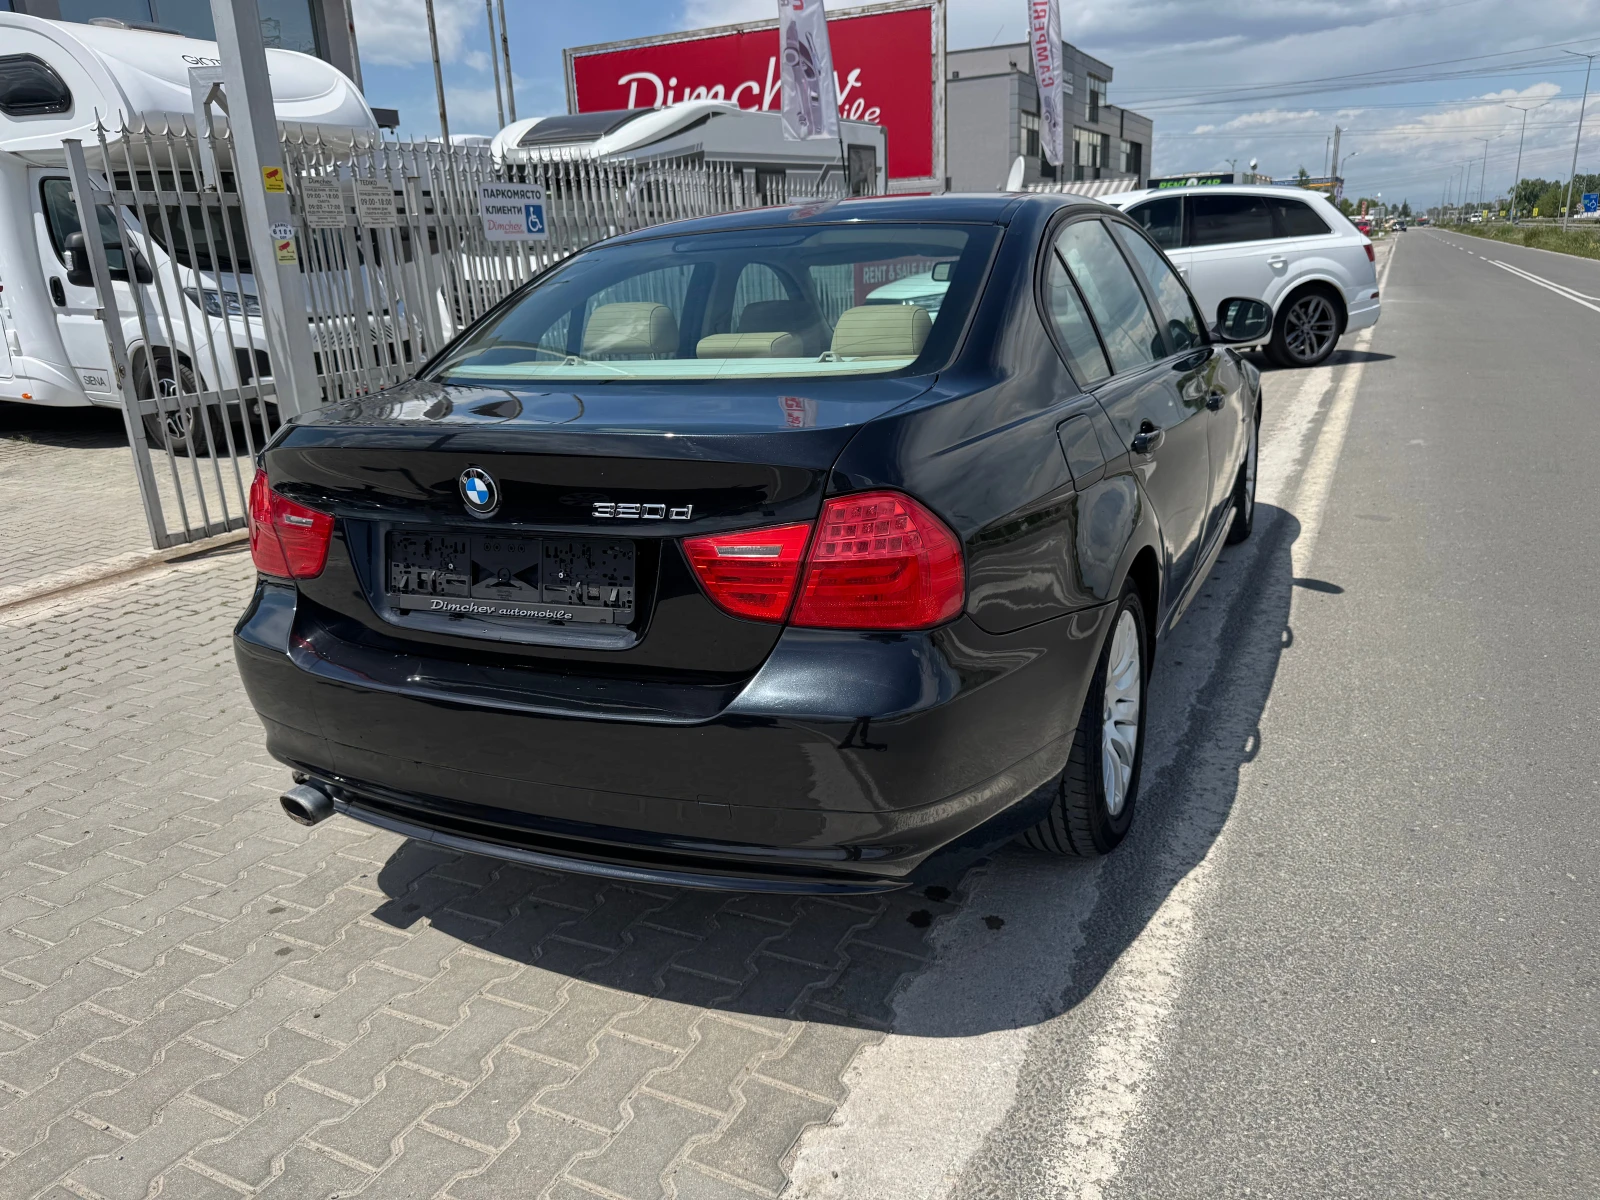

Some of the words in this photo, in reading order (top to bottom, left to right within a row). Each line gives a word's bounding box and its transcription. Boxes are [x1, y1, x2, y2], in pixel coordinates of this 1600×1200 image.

[483, 189, 541, 200] ПАРКОМЯСТО
[485, 205, 523, 216] КЛИЕНТИ
[488, 219, 522, 231] Dimchev
[863, 265, 887, 284] RENT
[83, 375, 107, 387] SIENA
[592, 502, 693, 520] 320d
[430, 599, 496, 614] Dimchev
[499, 606, 573, 620] automobile
